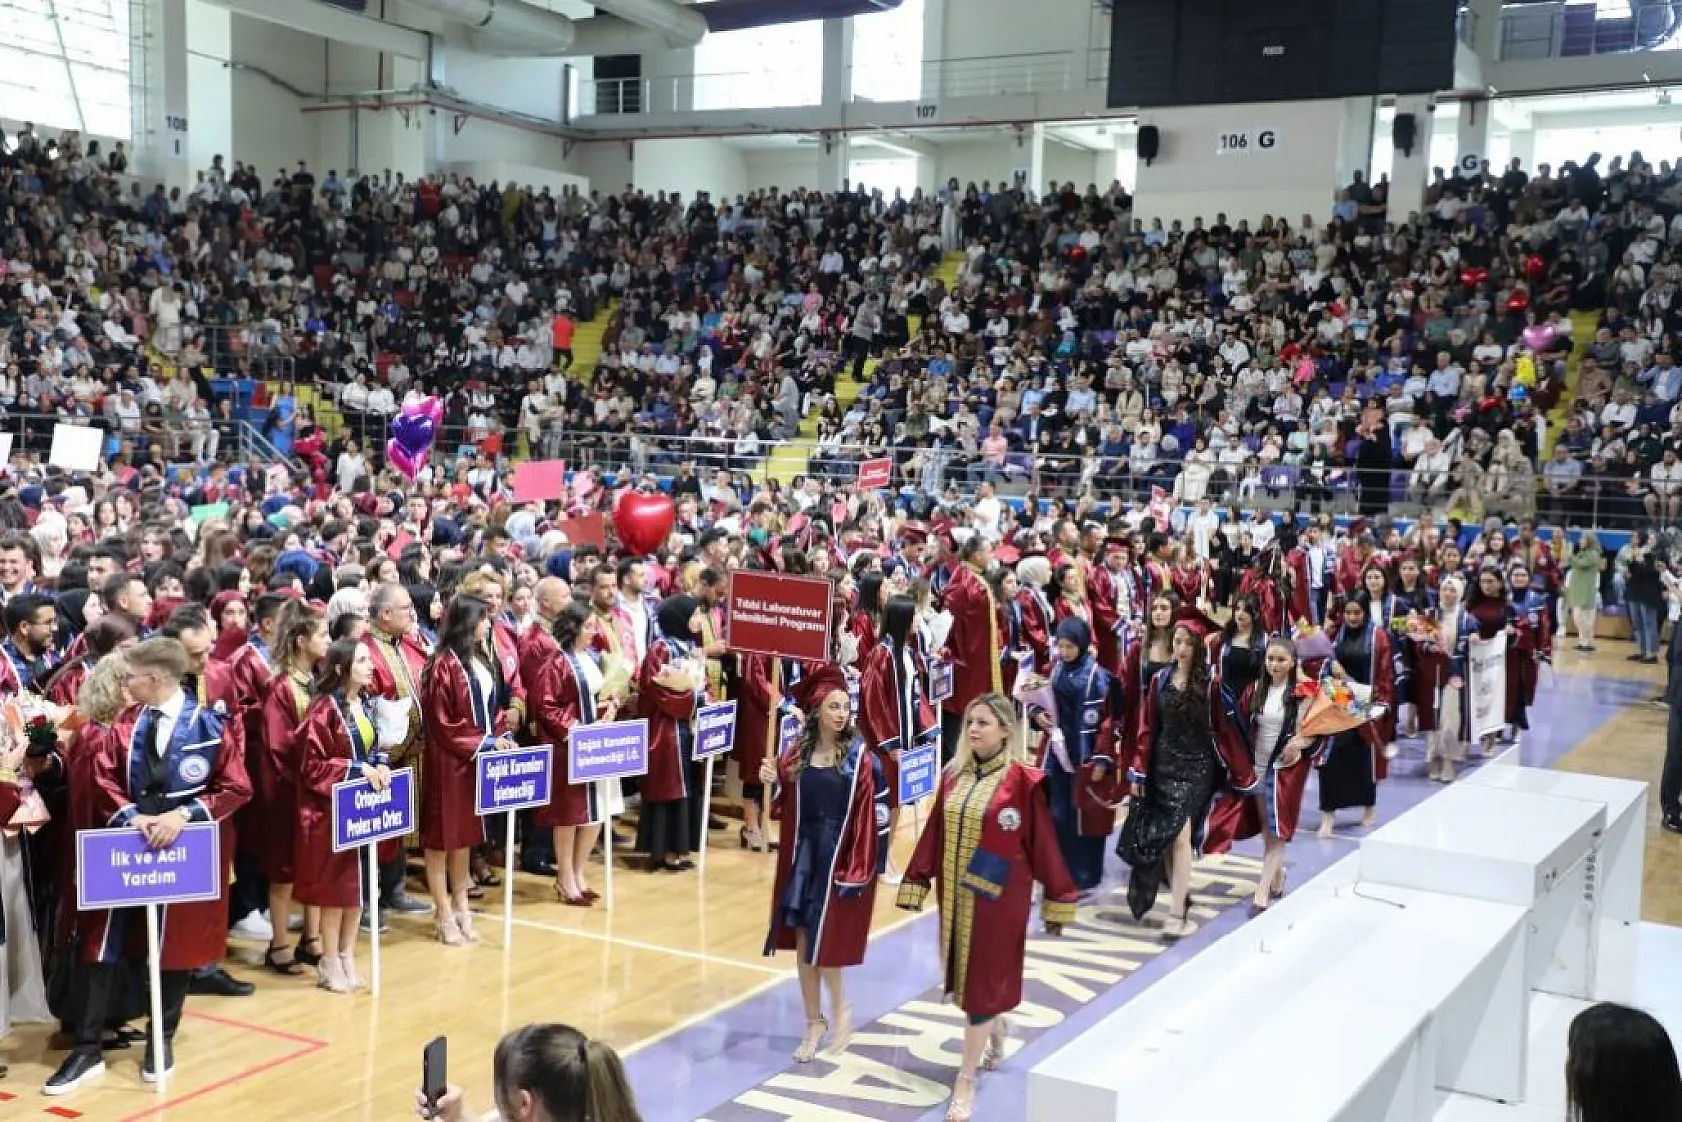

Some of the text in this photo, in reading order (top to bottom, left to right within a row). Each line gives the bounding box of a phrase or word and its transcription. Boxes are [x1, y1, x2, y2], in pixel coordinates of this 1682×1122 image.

[916, 105, 937, 118] 107
[165, 115, 188, 131] 108
[1220, 130, 1276, 149] 106 G
[1462, 154, 1477, 170] G
[732, 609, 778, 626] Teknikleri
[762, 600, 822, 619] Laboratuvar
[111, 846, 187, 867] İlk ve Acil
[121, 869, 176, 887] Yardım
